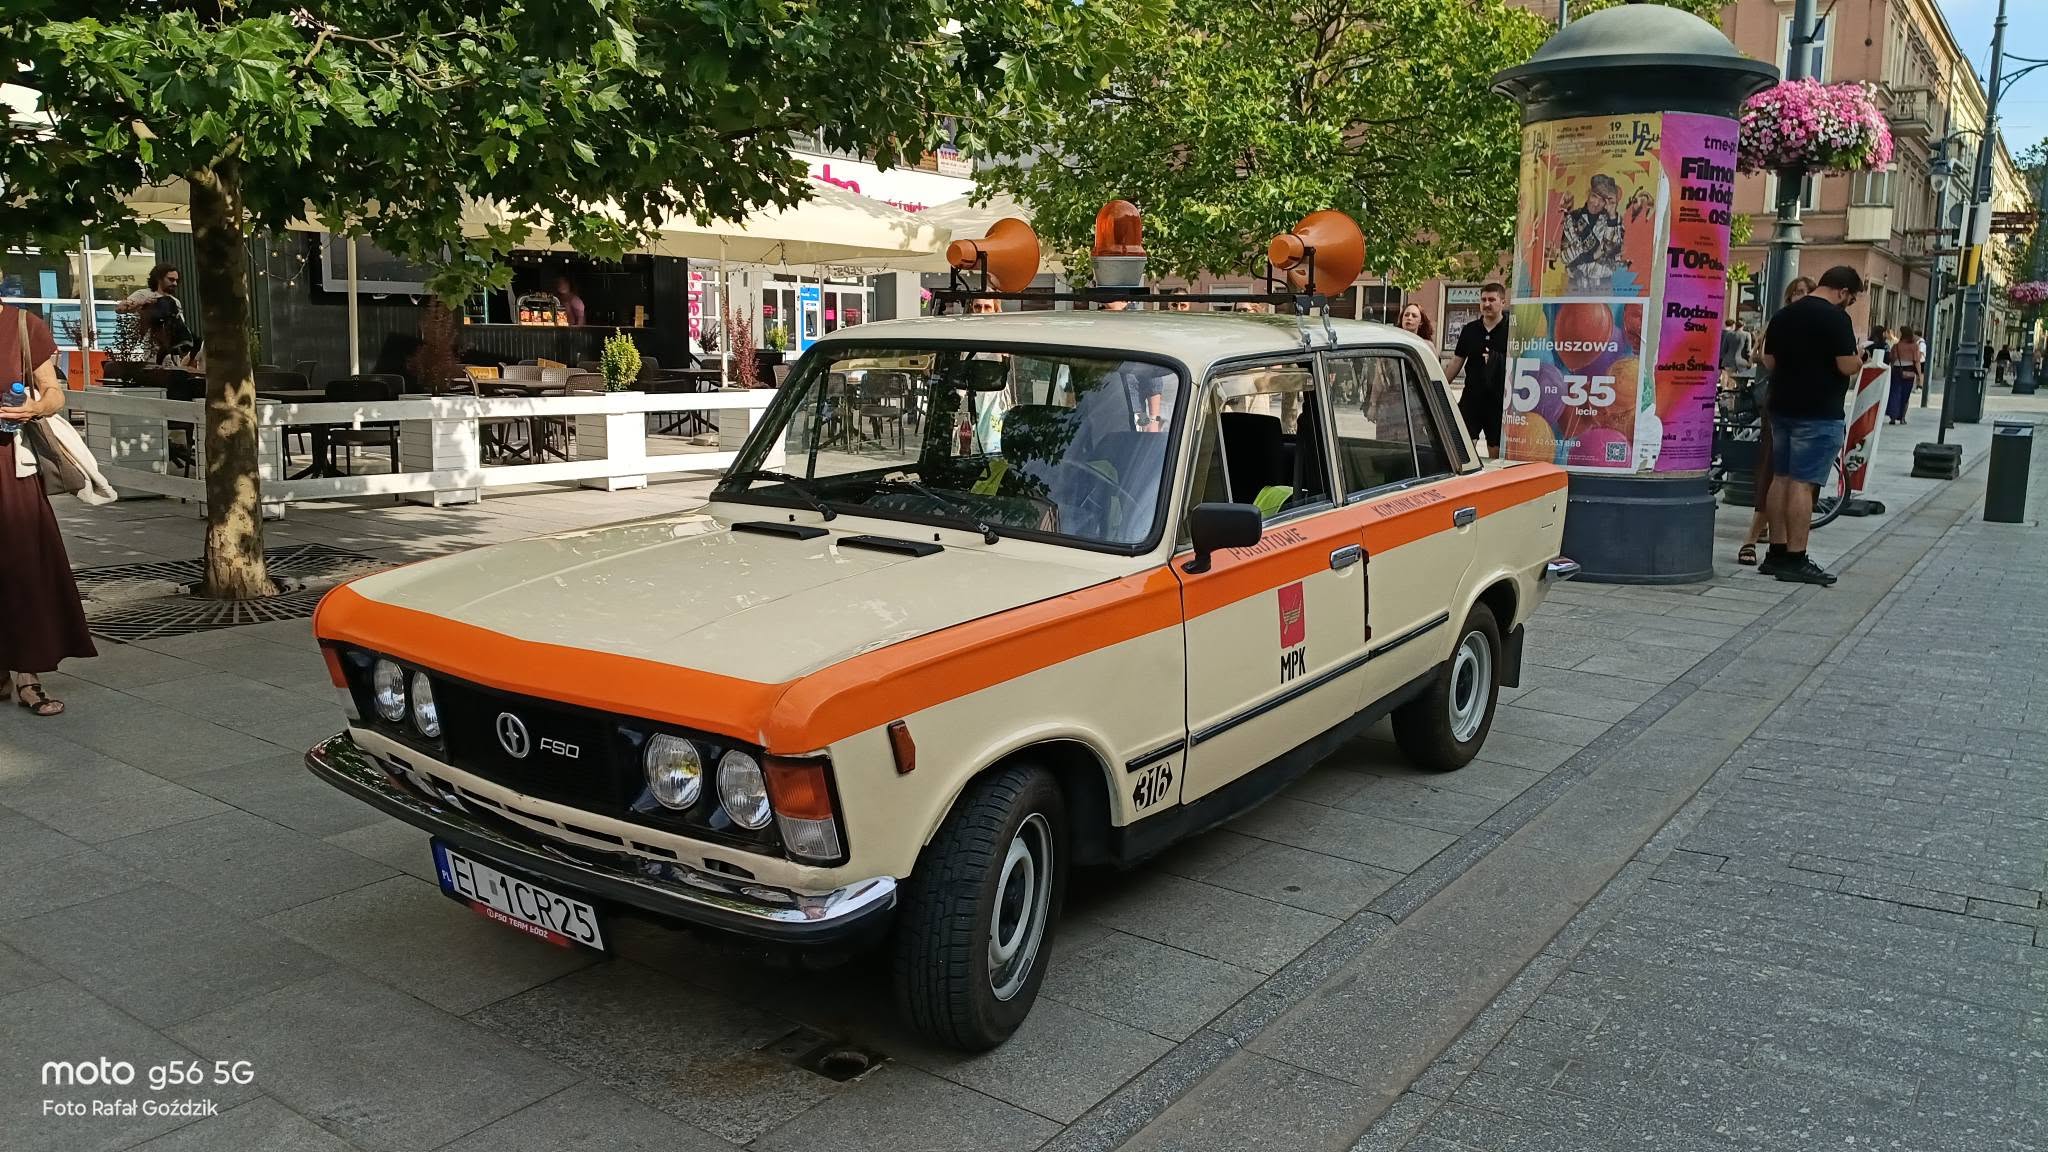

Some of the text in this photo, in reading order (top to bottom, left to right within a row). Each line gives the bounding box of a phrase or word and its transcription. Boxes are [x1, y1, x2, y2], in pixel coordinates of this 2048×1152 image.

[1610, 121, 1622, 132] 19
[1681, 186, 1708, 202] na
[1520, 338, 1618, 353] jubileuszowa
[1544, 385, 1558, 394] na
[1561, 375, 1616, 407] 35
[1575, 407, 1598, 416] lecie
[1280, 646, 1306, 684] MPK
[540, 737, 579, 758] FSO
[1136, 763, 1169, 810] 316
[442, 870, 452, 882] PL
[451, 854, 595, 943] EL 1CR25
[494, 912, 507, 923] FSO
[509, 917, 528, 931] TEAM
